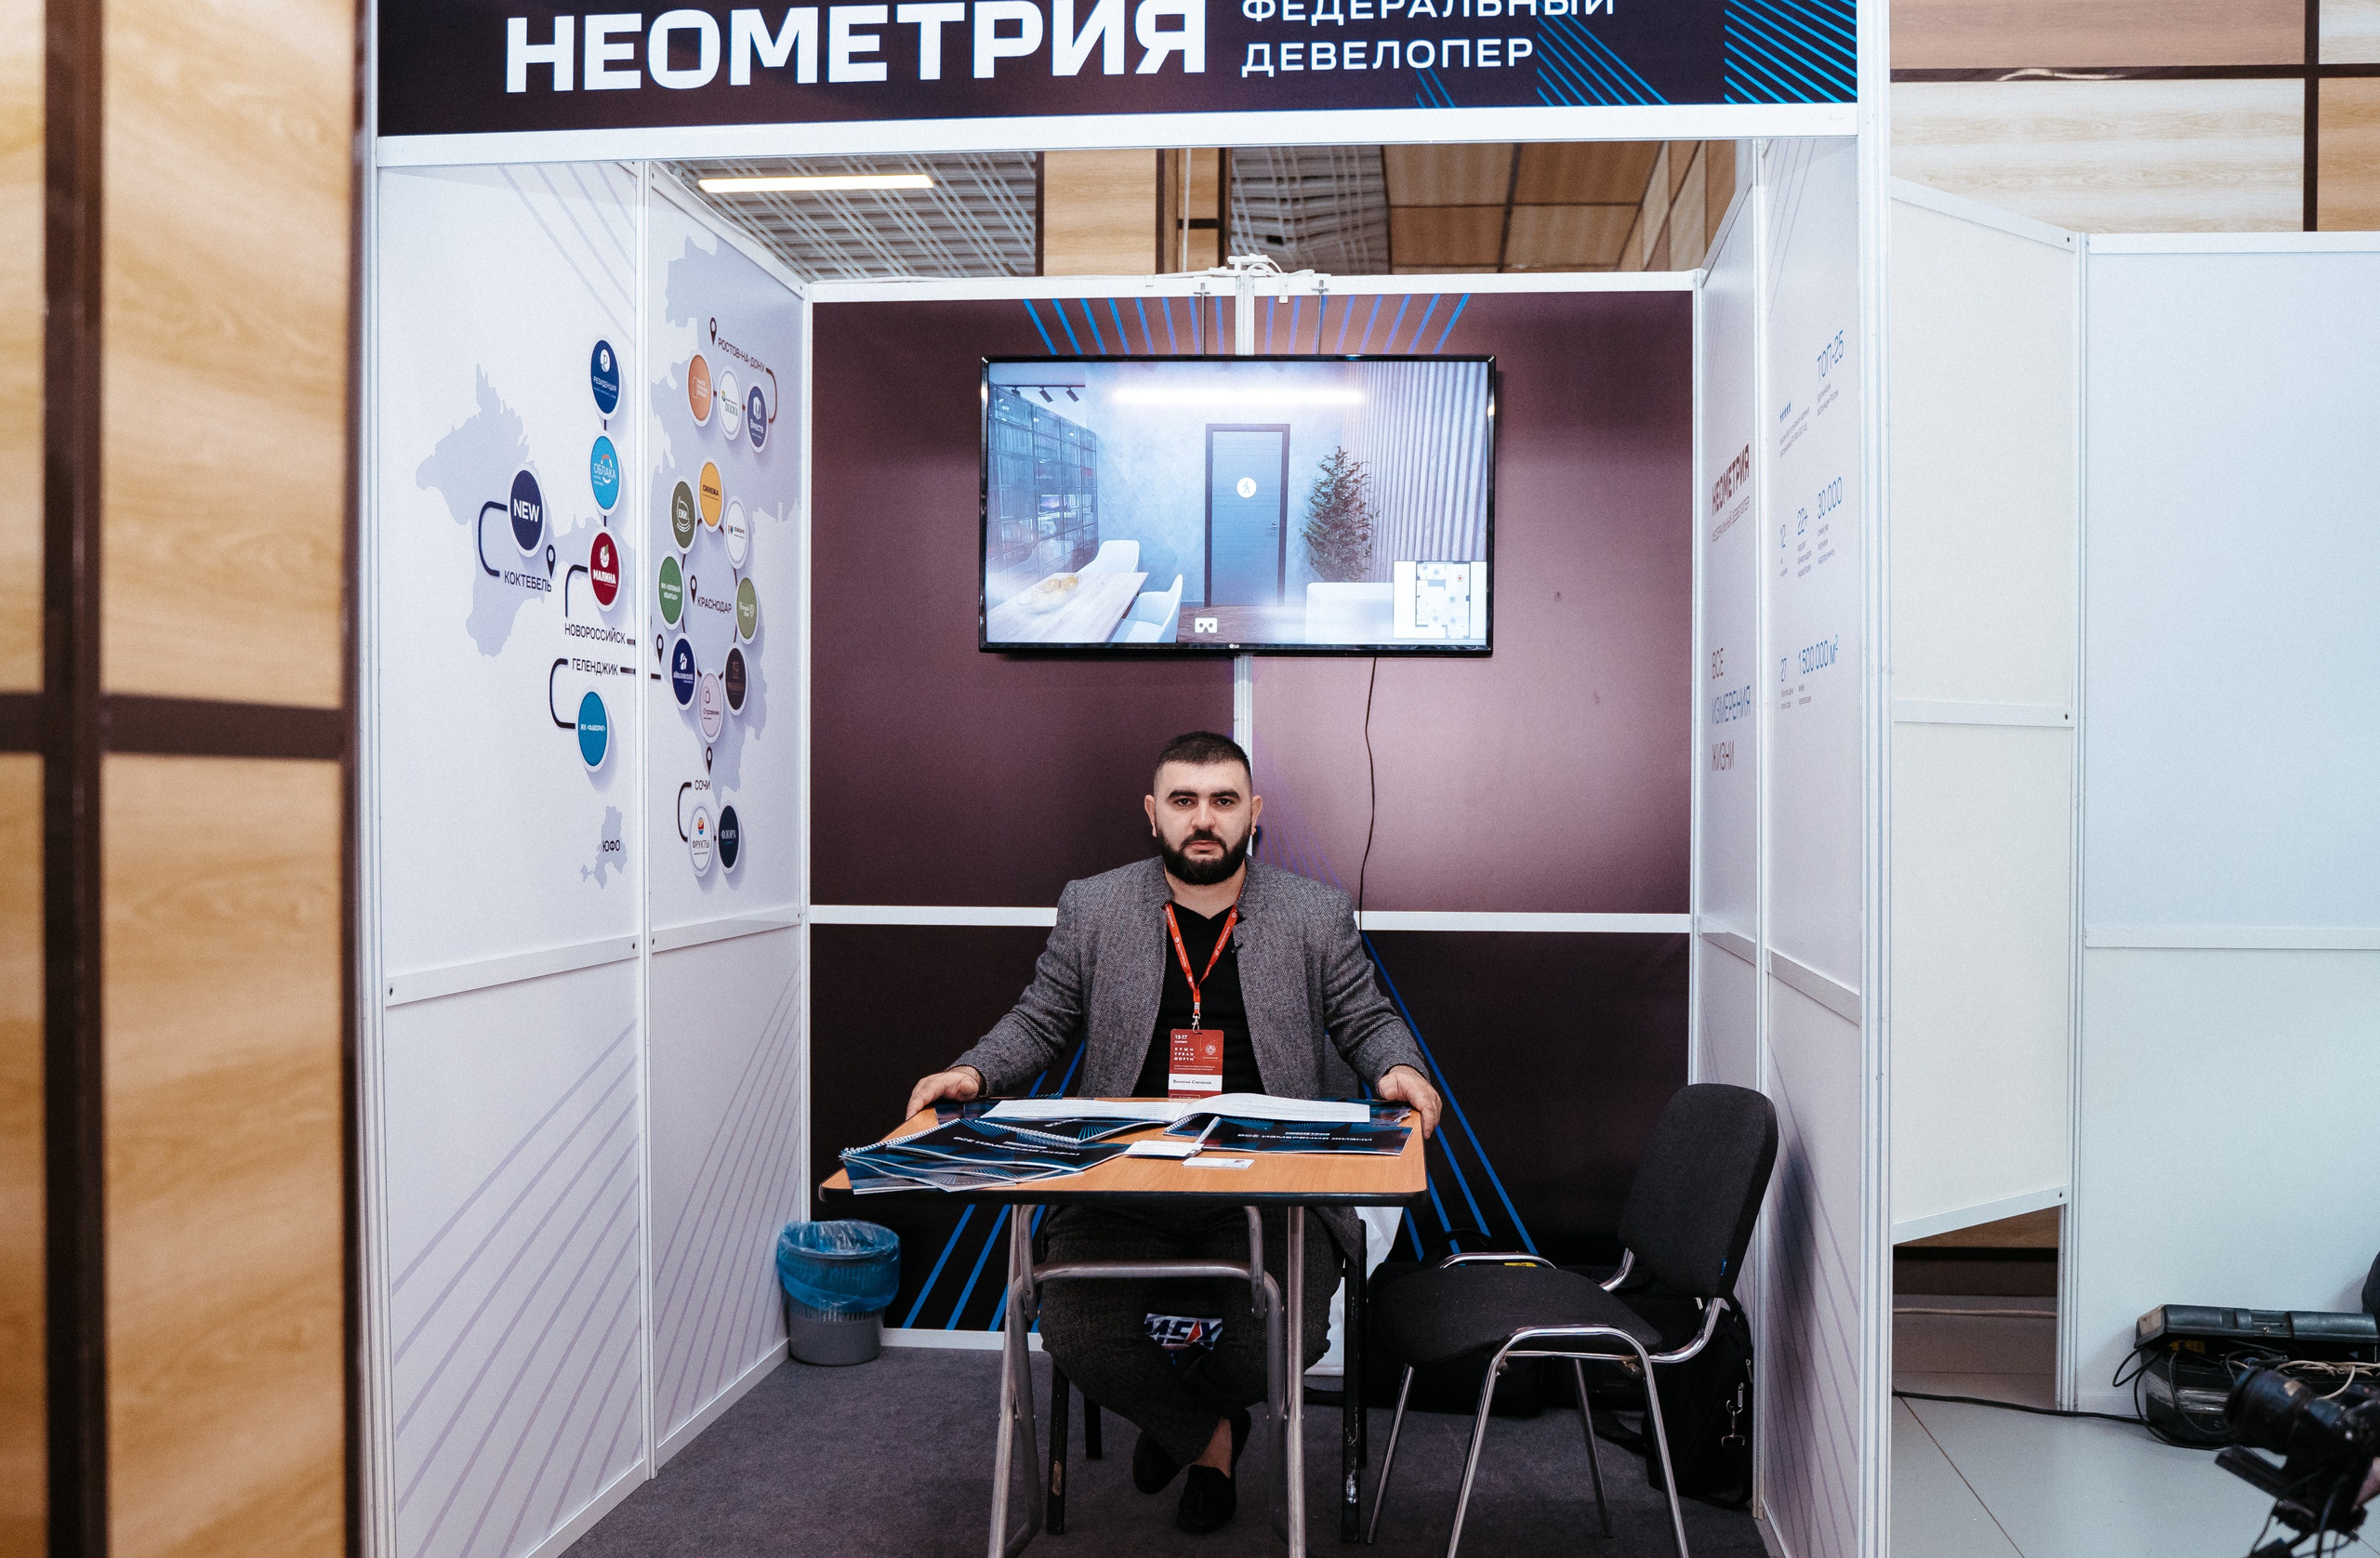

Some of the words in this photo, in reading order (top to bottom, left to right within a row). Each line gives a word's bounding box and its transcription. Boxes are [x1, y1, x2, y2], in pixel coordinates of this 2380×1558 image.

[506, 0, 1206, 93] НЕОМЕТРИЯ
[1241, 38, 1533, 77] ДЕВЕЛОПЕР
[718, 337, 765, 373] РОСТОВ-НА-ДОНУ
[1817, 329, 1844, 382] ТОП-25
[593, 463, 616, 480] ОБЛАКА
[1712, 443, 1750, 517] НЕОМЕТРИЯ
[513, 498, 540, 522] NEW
[504, 570, 552, 592] КОКТЕБЕЛЬ
[592, 569, 616, 585] МАЛИНА
[697, 596, 733, 614] КРАСНОДАР
[564, 623, 626, 644] НОВОРОССИЙСК
[572, 658, 618, 676] ГЕЛЕНДЖИК
[1712, 647, 1725, 680] ВСЕ
[1712, 685, 1751, 725] ИЗМЕРЕНИЯ
[1712, 741, 1735, 771] ЖИЗНИ
[694, 780, 711, 791] СОЧИ
[602, 839, 621, 852] ЮФО
[692, 839, 710, 850] ФРУКТЫ
